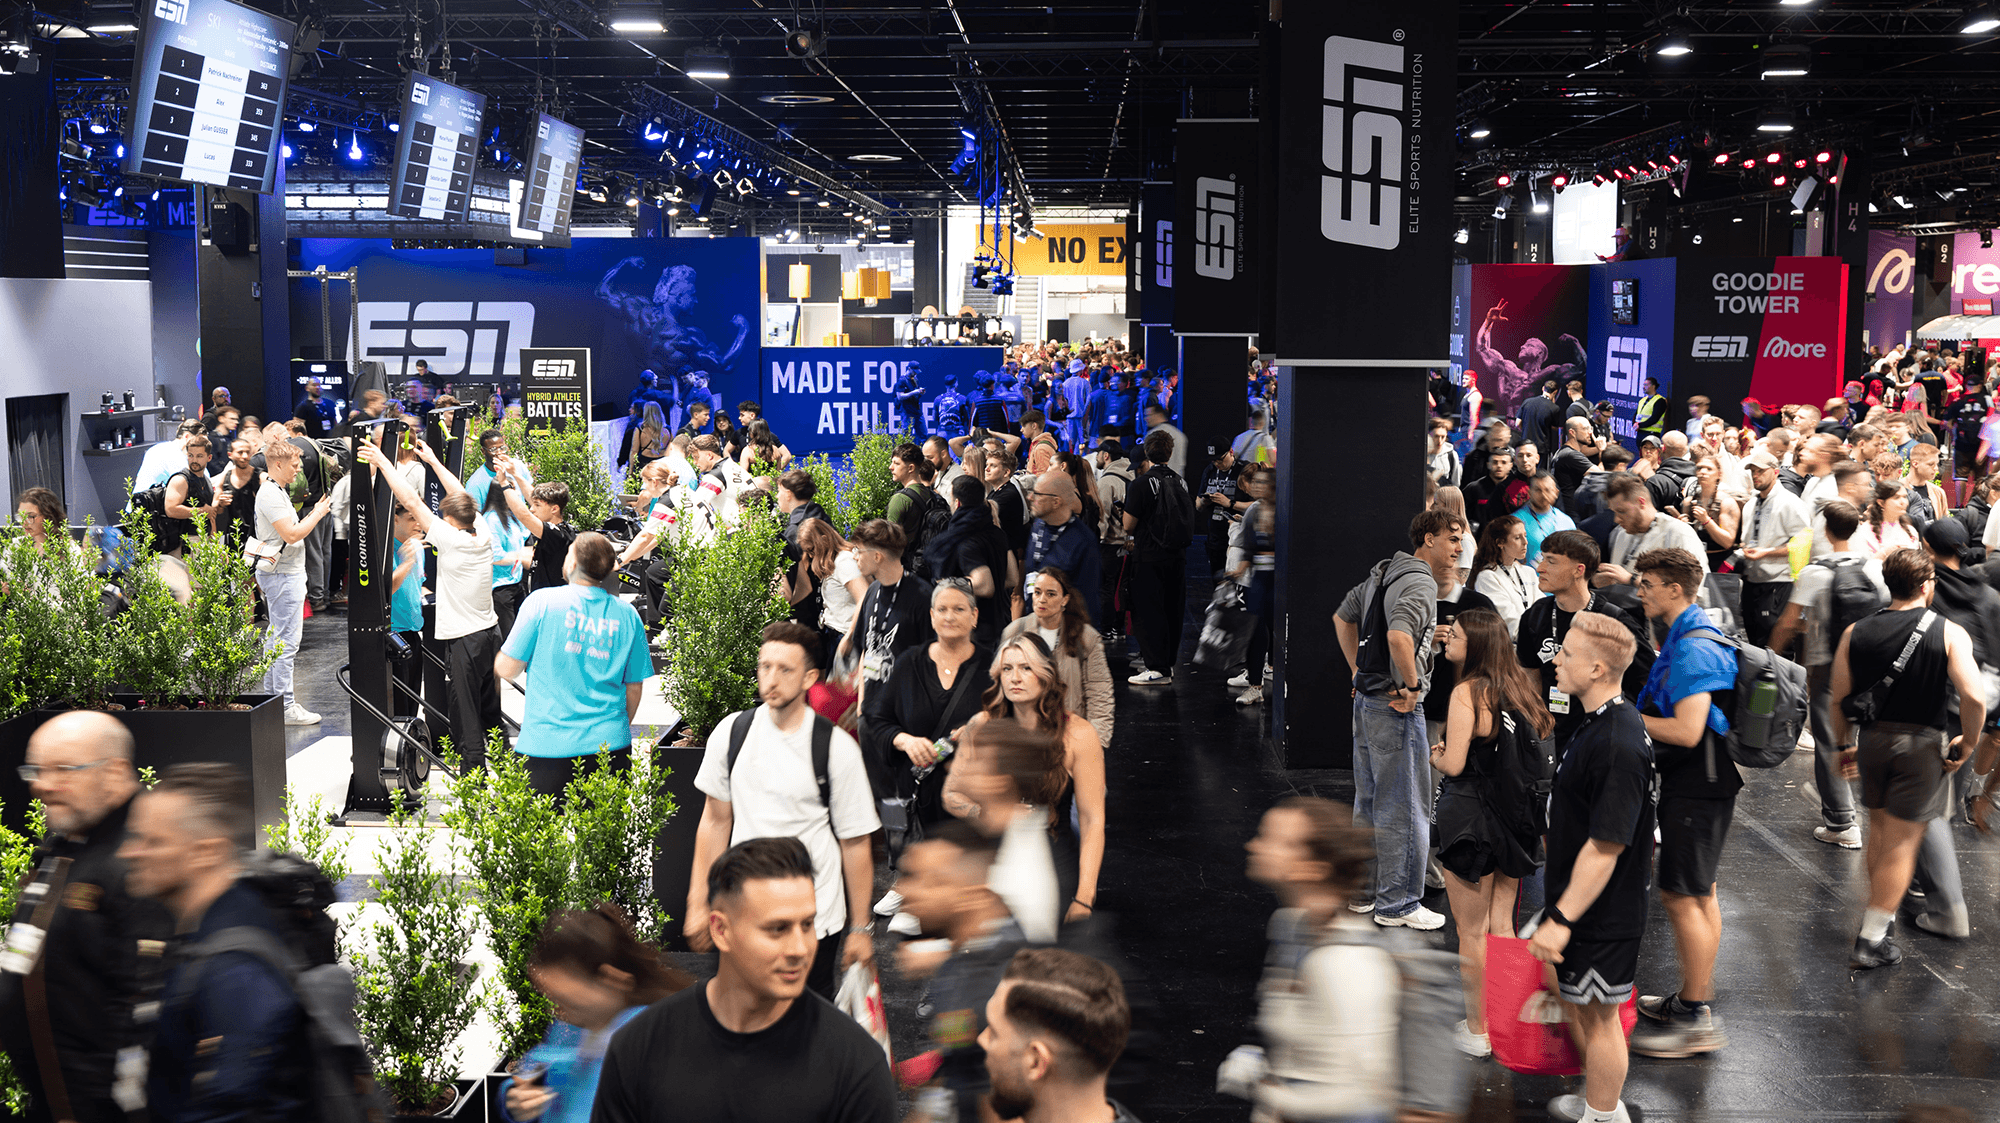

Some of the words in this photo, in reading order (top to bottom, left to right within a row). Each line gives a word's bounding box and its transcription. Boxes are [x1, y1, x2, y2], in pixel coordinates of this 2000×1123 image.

[207, 12, 221, 30] SKI
[175, 87, 180, 96] 2
[1412, 53, 1423, 128] NUTRITION
[169, 116, 174, 124] 3
[164, 144, 169, 152] 4
[1321, 35, 1404, 249] ESN
[1410, 134, 1422, 190] SPORTS
[1409, 197, 1420, 233] ELITE
[1848, 202, 1859, 216] H
[647, 228, 654, 238] K
[1196, 176, 1236, 281] ESN
[1649, 226, 1657, 237] H
[1848, 218, 1857, 232] 4
[1048, 236, 1086, 263] NO
[1531, 243, 1538, 253] H
[1649, 238, 1656, 250] 3
[1940, 244, 1948, 253] G
[1531, 253, 1537, 263] 2
[1940, 253, 1947, 263] 2
[1712, 272, 1805, 291] GOODIE
[1714, 295, 1800, 314] TOWER
[345, 301, 535, 375] ESN
[1691, 335, 1749, 358] ESN
[1763, 335, 1827, 358] More
[532, 359, 577, 377] ESN
[1605, 336, 1649, 398] ESN
[772, 361, 851, 394] MADE
[527, 392, 552, 401] HYBRID
[553, 392, 581, 401] ATHLETE
[527, 402, 582, 418] BATTLES
[817, 402, 937, 434] ATHLEE
[430, 482, 438, 490] 2
[356, 503, 366, 512] 2
[357, 513, 368, 568] concept
[565, 610, 620, 637] STAFF
